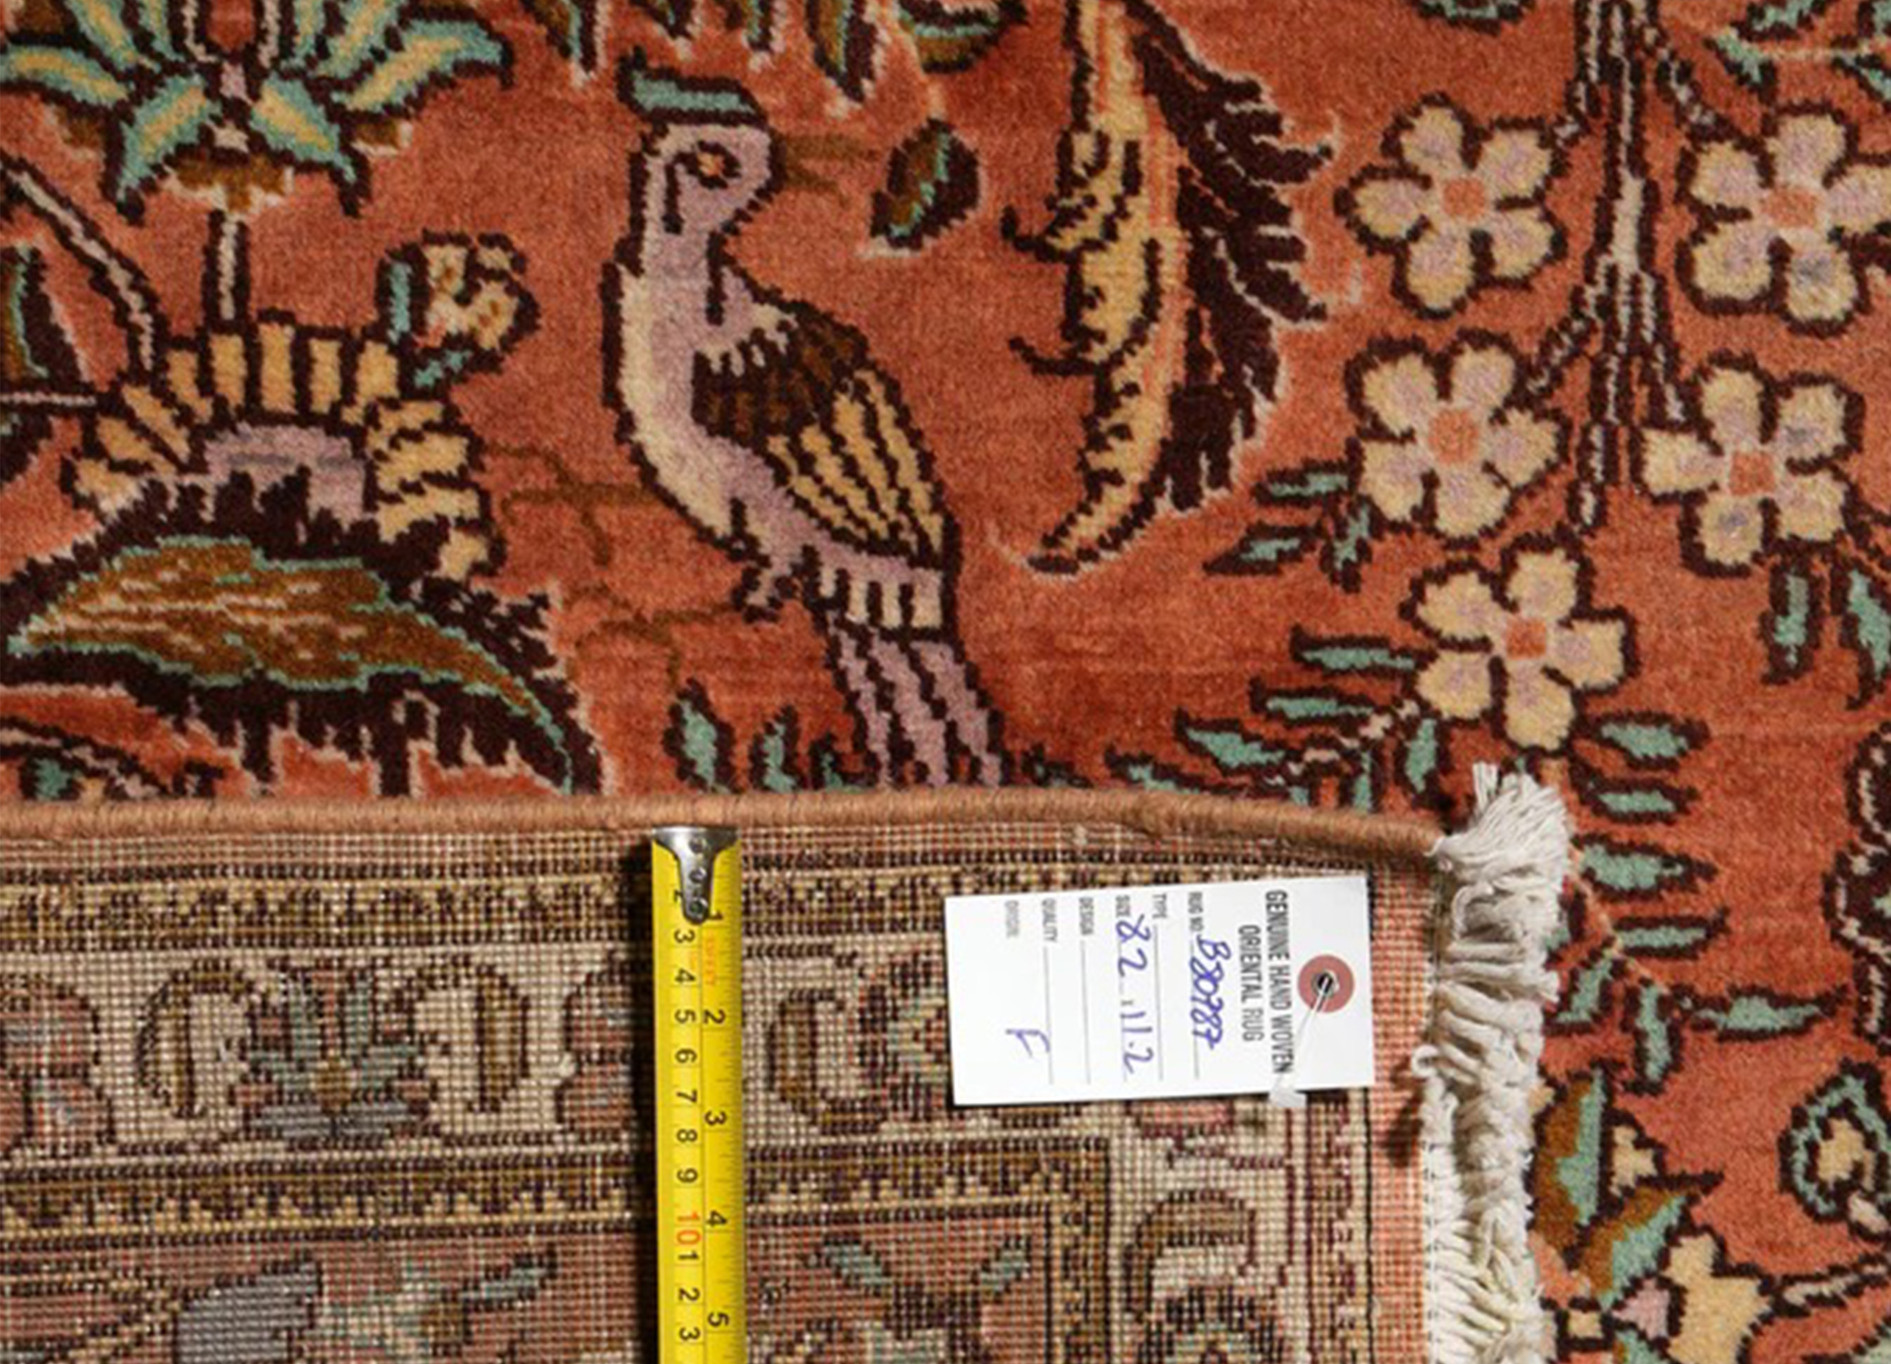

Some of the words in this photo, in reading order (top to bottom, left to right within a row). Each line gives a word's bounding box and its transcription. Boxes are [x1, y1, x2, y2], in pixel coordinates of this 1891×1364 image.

[1116, 895, 1130, 917] SIZE
[1153, 893, 1166, 919] TYPE
[1188, 892, 1202, 913] RUG
[1042, 898, 1057, 942] QUALITY
[1079, 897, 1093, 935] DESIGN
[1266, 890, 1289, 960] GENUINE
[673, 930, 696, 944] 3
[1239, 925, 1261, 1001] ORIENTAL
[675, 968, 696, 983] 4
[1268, 965, 1291, 1010] HAND
[674, 1009, 696, 1024] 5
[703, 1009, 726, 1025] 2
[1241, 1007, 1264, 1041] RUG
[1271, 1018, 1294, 1073] WOVEN
[675, 1048, 697, 1064] 6
[676, 1089, 698, 1104] 7
[704, 1111, 728, 1126] 3
[676, 1129, 698, 1143] 8
[676, 1168, 699, 1183] 9
[706, 1210, 728, 1227] 4
[676, 1211, 702, 1246] 10
[678, 1251, 699, 1260] 1
[678, 1287, 700, 1302] 2
[707, 1312, 730, 1328] 5
[678, 1327, 701, 1341] 3
